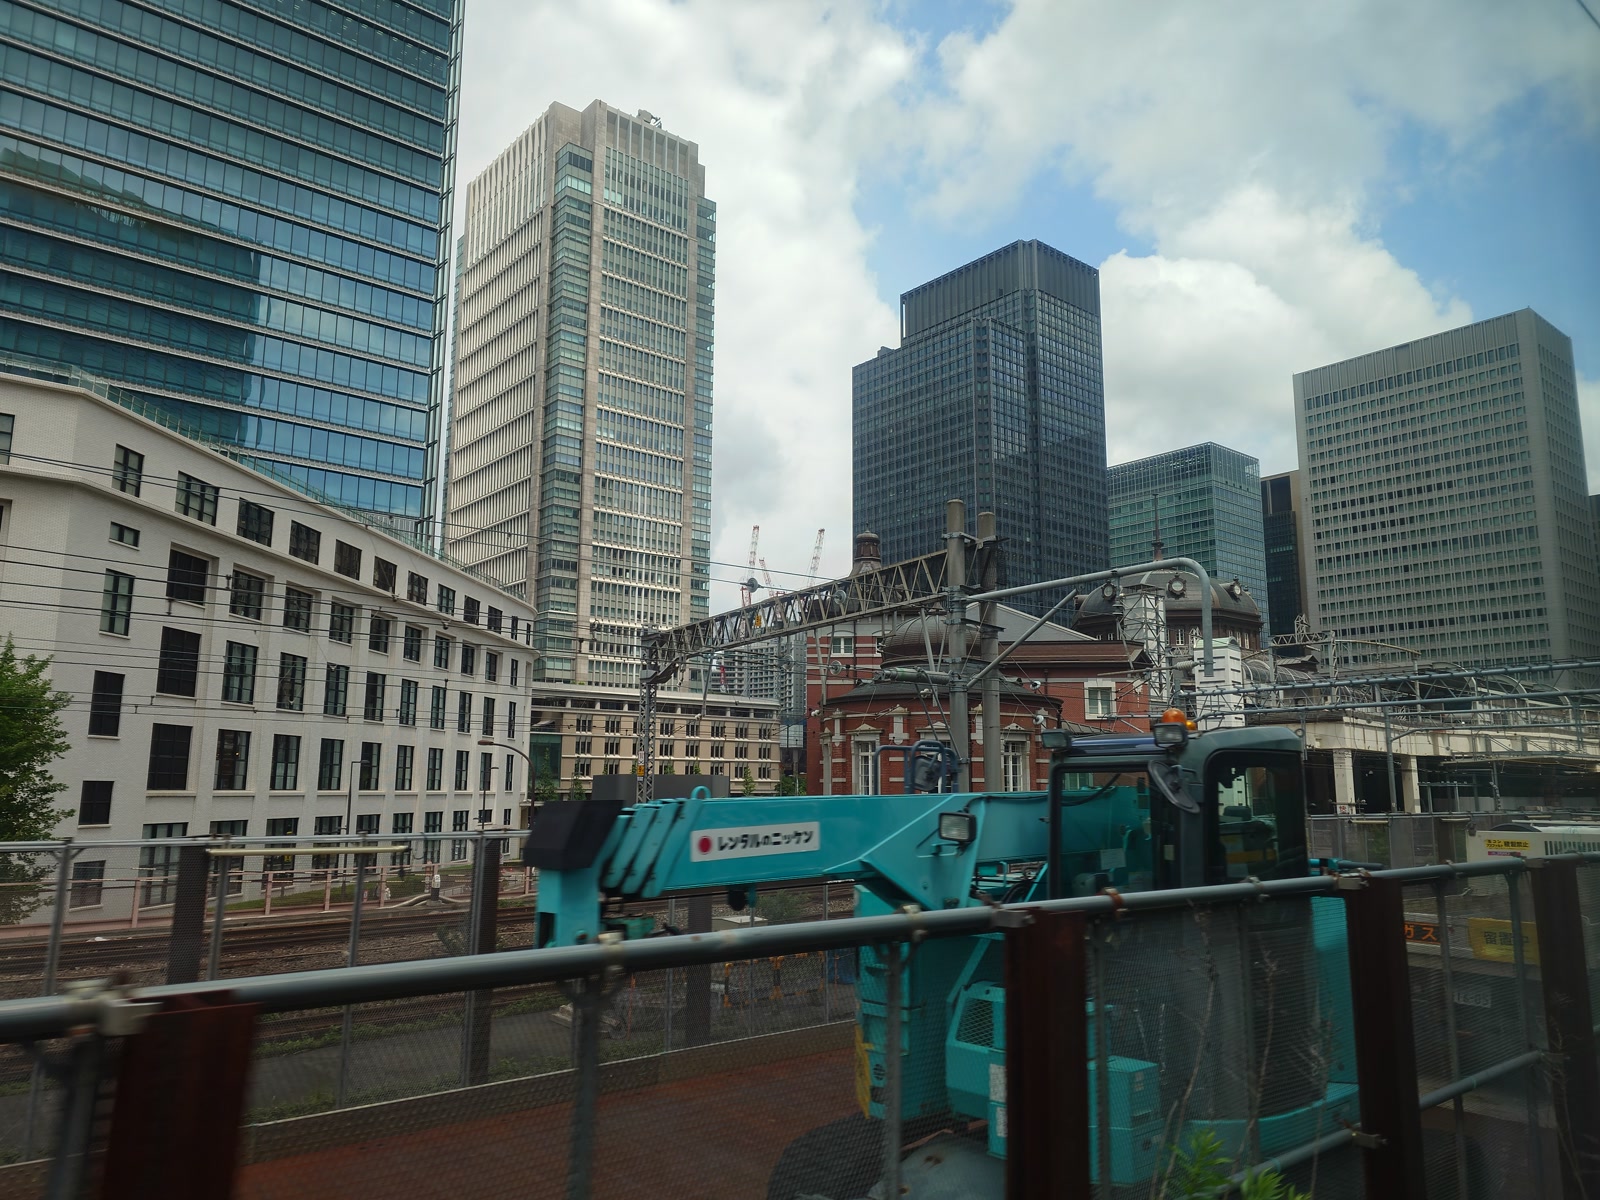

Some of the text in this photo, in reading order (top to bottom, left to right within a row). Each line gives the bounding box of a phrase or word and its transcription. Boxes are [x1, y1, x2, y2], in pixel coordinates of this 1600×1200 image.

[717, 831, 813, 851] レンタルのニッケン
